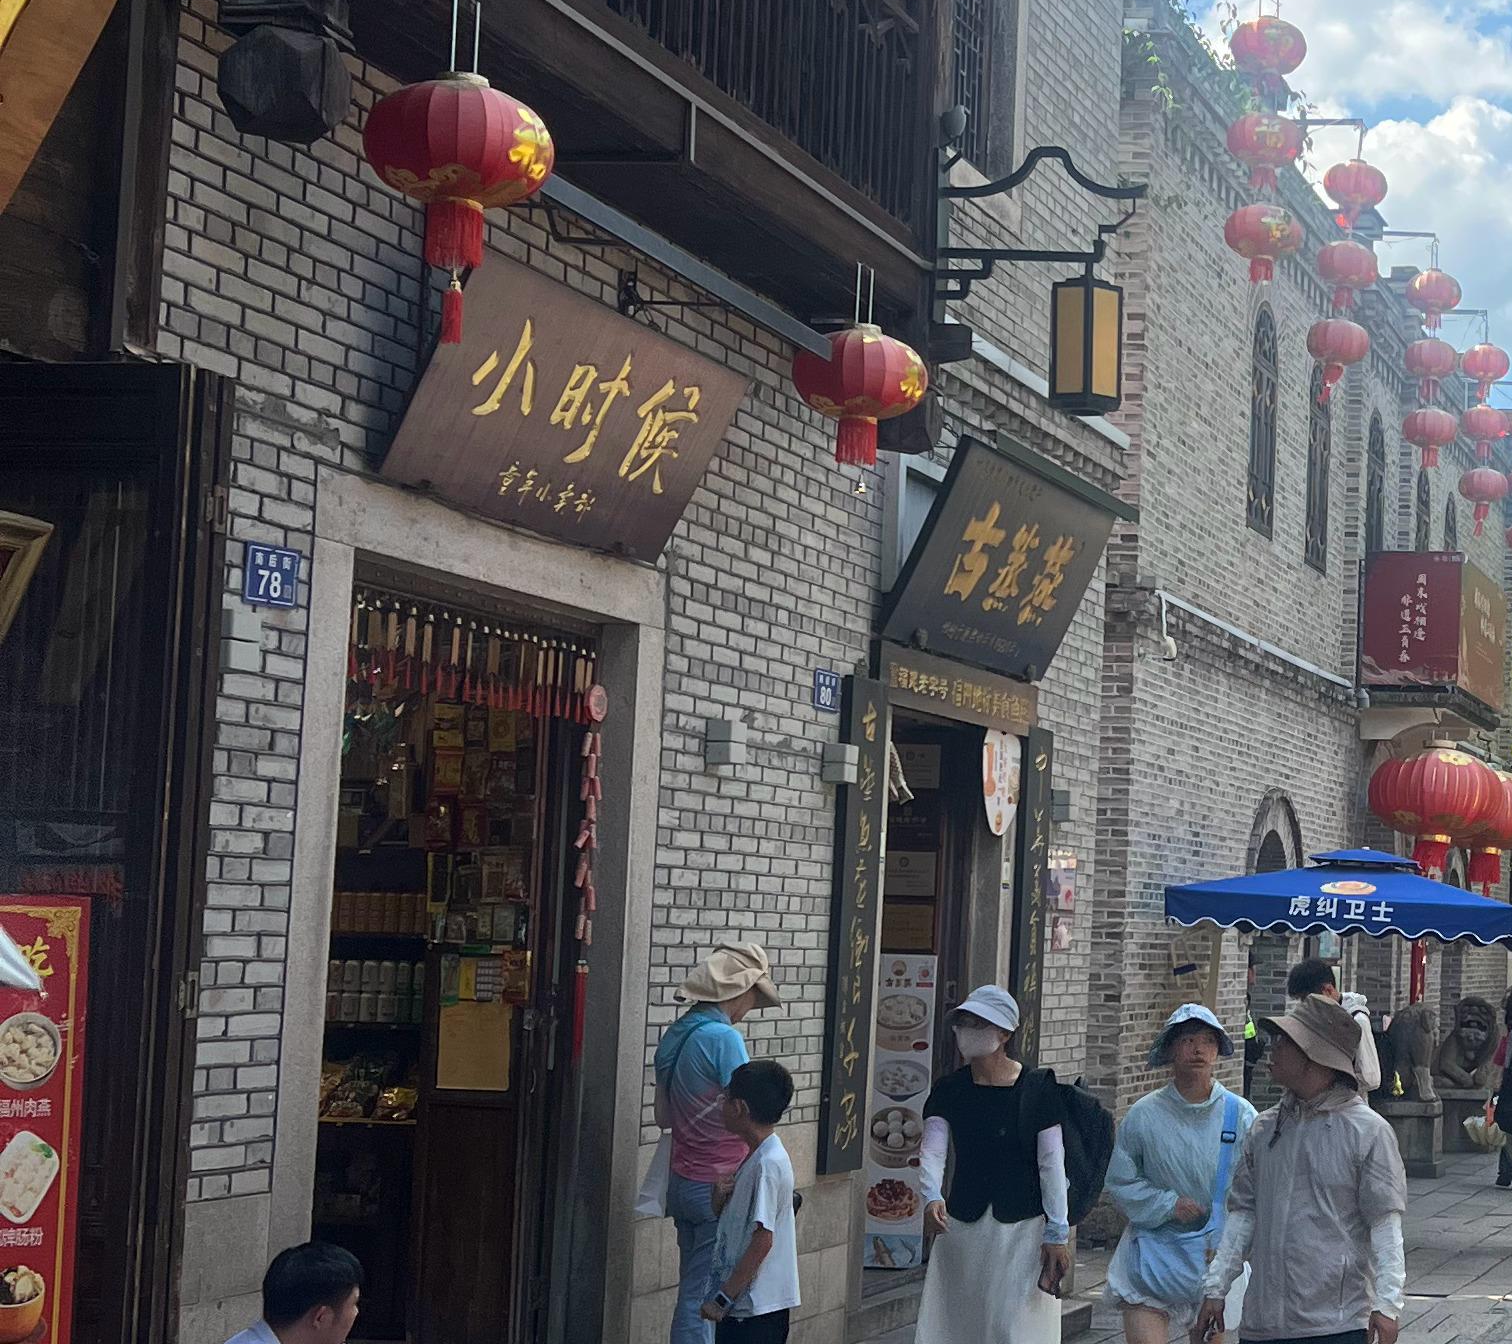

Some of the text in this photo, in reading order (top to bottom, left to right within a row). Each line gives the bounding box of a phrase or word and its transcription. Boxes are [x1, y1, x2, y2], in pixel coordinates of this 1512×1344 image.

[471, 318, 701, 495] 小时候
[254, 552, 293, 571] 南后街
[820, 685, 832, 706] 80
[1288, 895, 1395, 923] 虎纠卫士
[0, 1227, 44, 1247] 牌肠粉
